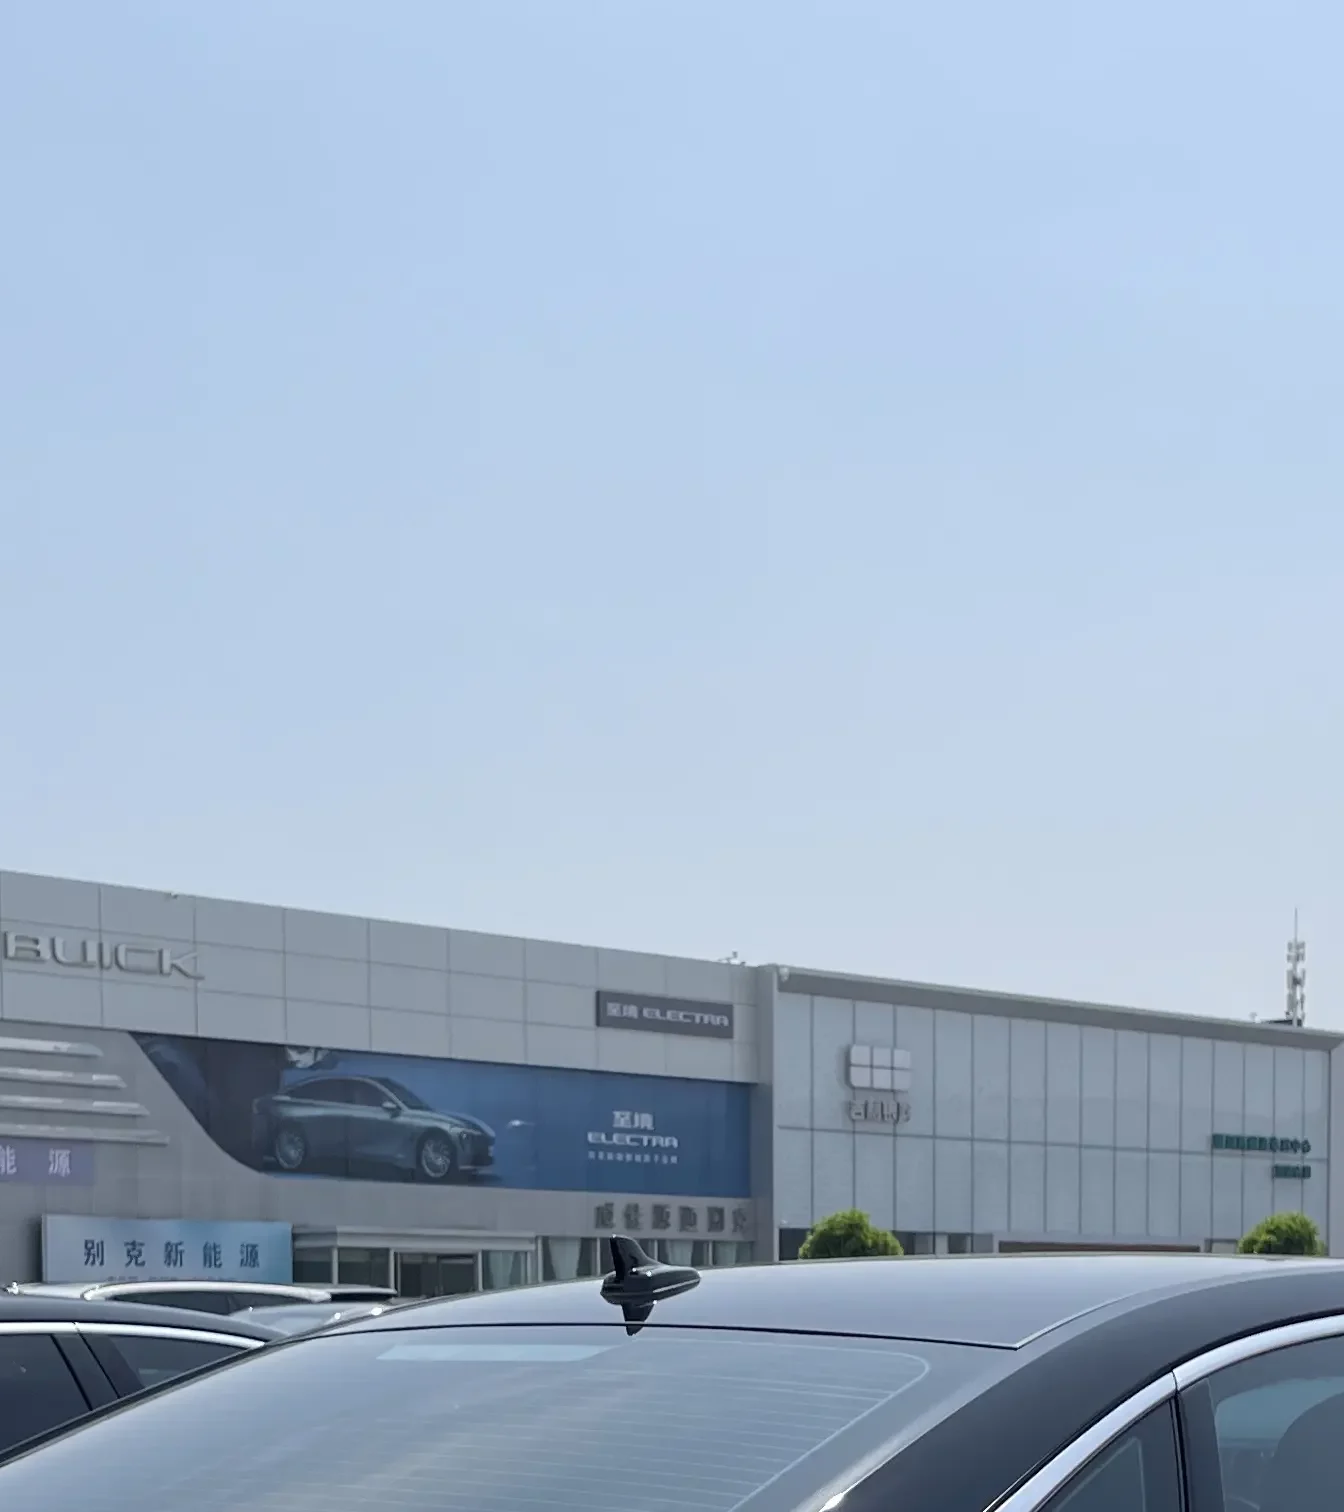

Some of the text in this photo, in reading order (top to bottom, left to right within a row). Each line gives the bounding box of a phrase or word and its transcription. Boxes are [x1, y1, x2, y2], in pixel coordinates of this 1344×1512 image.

[4, 931, 205, 980] BUICK
[642, 1007, 730, 1028] ELECTRA
[587, 1131, 679, 1149] ELECTRA
[83, 1238, 261, 1269] 别克新能源
